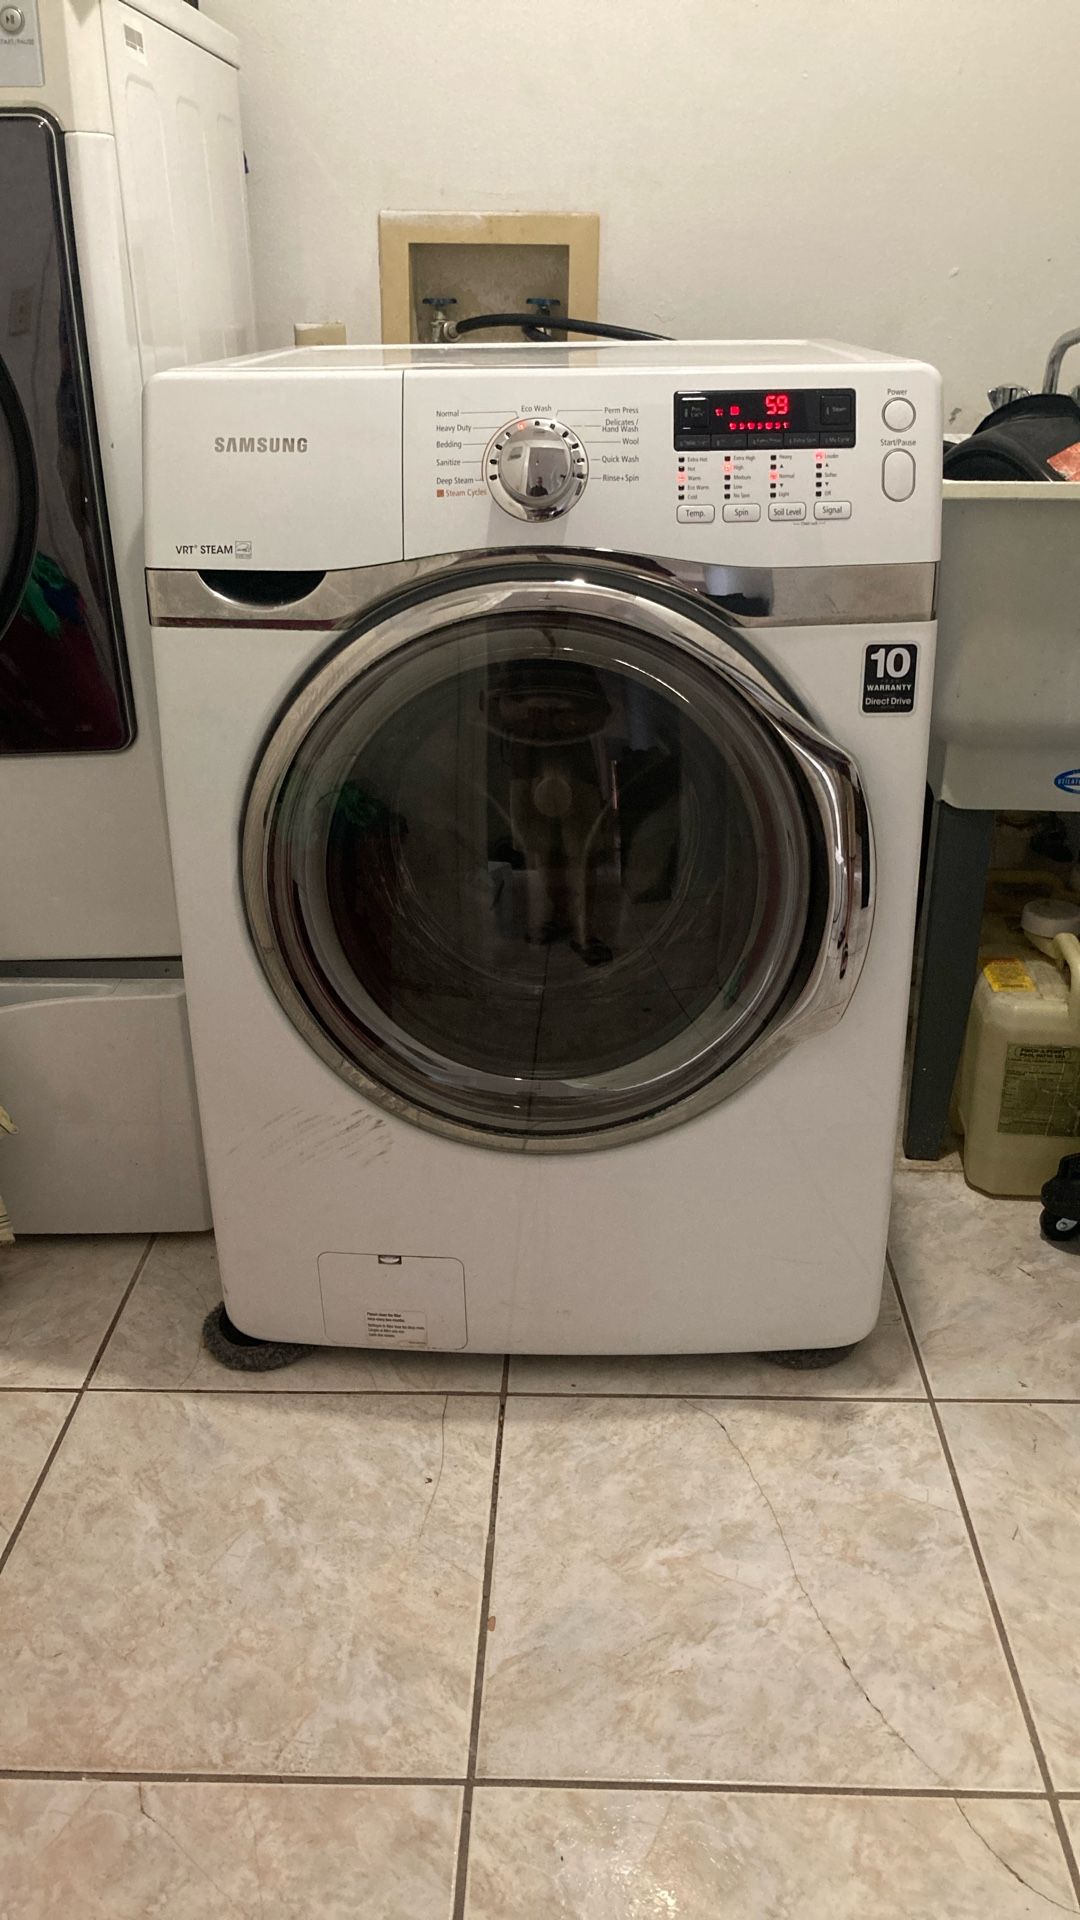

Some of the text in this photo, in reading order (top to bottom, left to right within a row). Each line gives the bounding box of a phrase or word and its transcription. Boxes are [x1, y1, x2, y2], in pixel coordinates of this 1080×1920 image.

[887, 388, 908, 396] Power
[521, 404, 552, 412] Eco Wash
[765, 394, 789, 415] 59
[436, 409, 460, 417] Normal
[604, 406, 639, 414] Perm Press
[605, 418, 635, 426] Delicates
[436, 424, 472, 433] Heavy Duty
[602, 425, 639, 433] Hand Wash
[214, 437, 308, 453] SAMSUNG
[436, 440, 462, 450] Bedding
[622, 437, 640, 445] Wool
[880, 438, 917, 447] Start/Pause
[436, 458, 461, 467] Sanitize
[602, 455, 640, 464] Quick Wash
[436, 476, 474, 486] Deep Steam
[602, 473, 640, 483] Rinse+Spin
[445, 488, 487, 498] Steam Cycles
[685, 509, 706, 519] Temp.
[734, 508, 749, 518] Spin
[773, 508, 802, 516] Soil Level
[822, 505, 843, 516] Signal
[200, 545, 233, 555] STEAM
[870, 647, 911, 678] 10
[865, 697, 912, 705] Direct Drive
